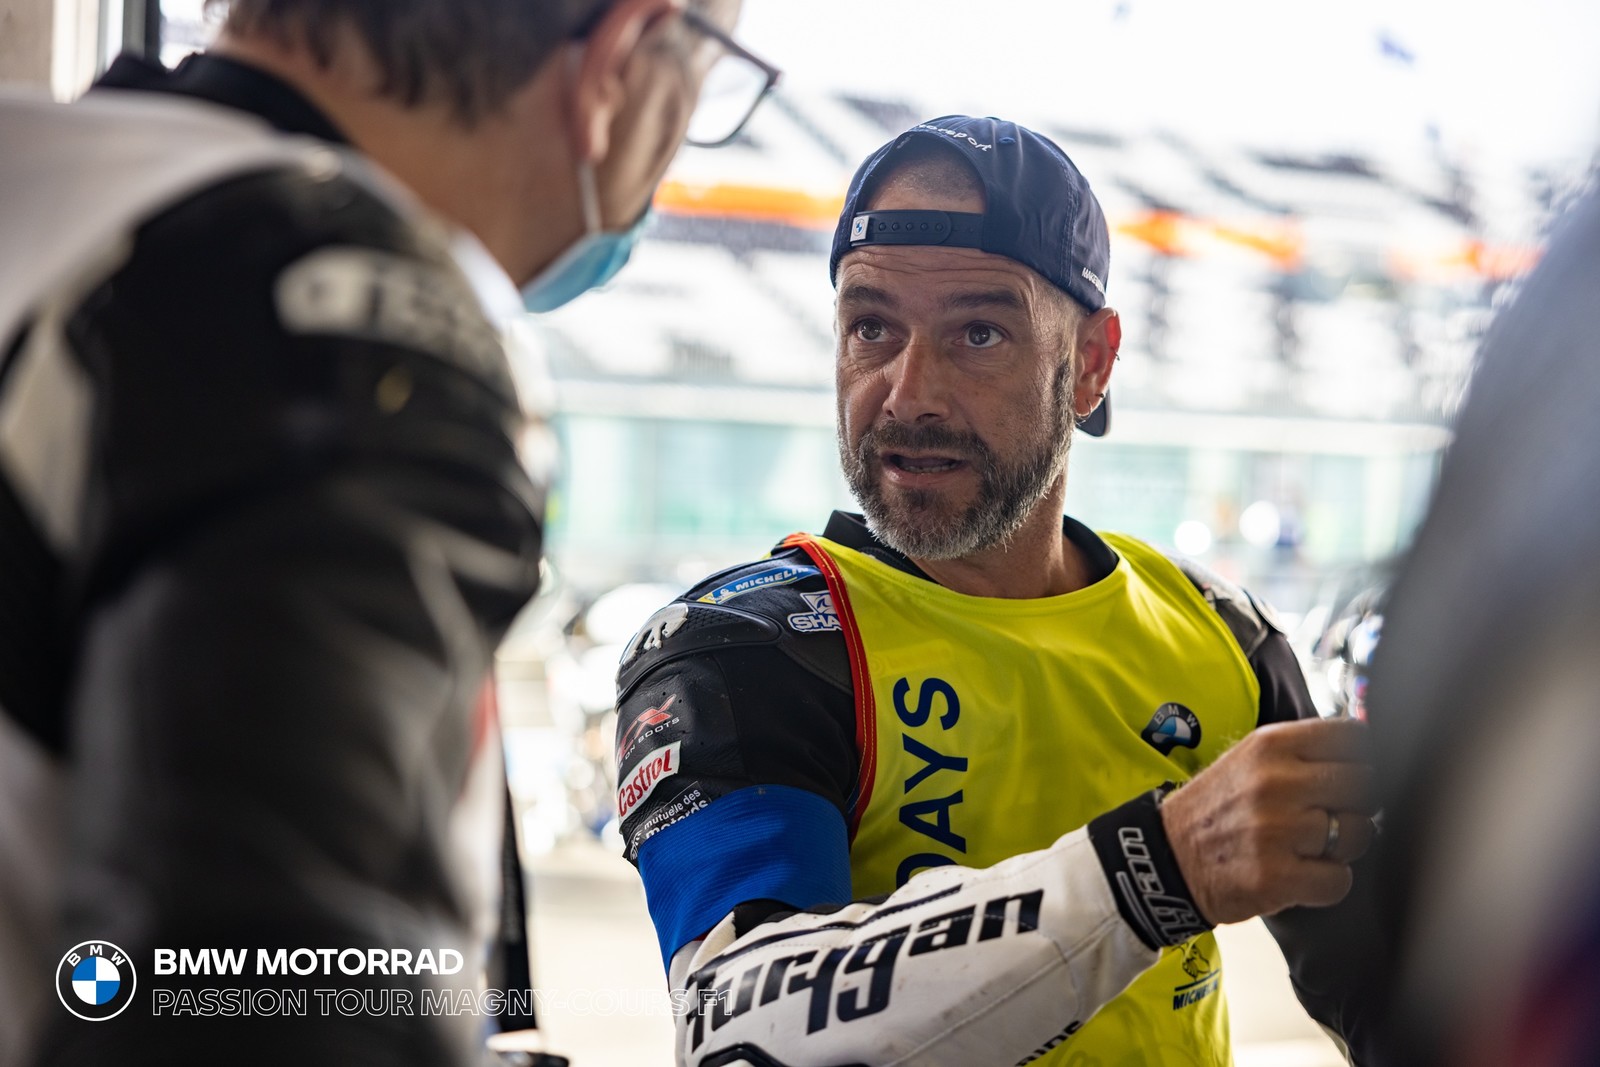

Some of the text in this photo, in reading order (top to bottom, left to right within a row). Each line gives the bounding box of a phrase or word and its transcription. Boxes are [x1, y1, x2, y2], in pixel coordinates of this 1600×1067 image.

[735, 568, 809, 591] MICHELIN
[792, 614, 842, 629] SHA
[1153, 704, 1198, 728] BMW
[638, 717, 680, 743] BOOTS
[618, 749, 672, 817] Castrol
[644, 789, 701, 830] mutuelle des
